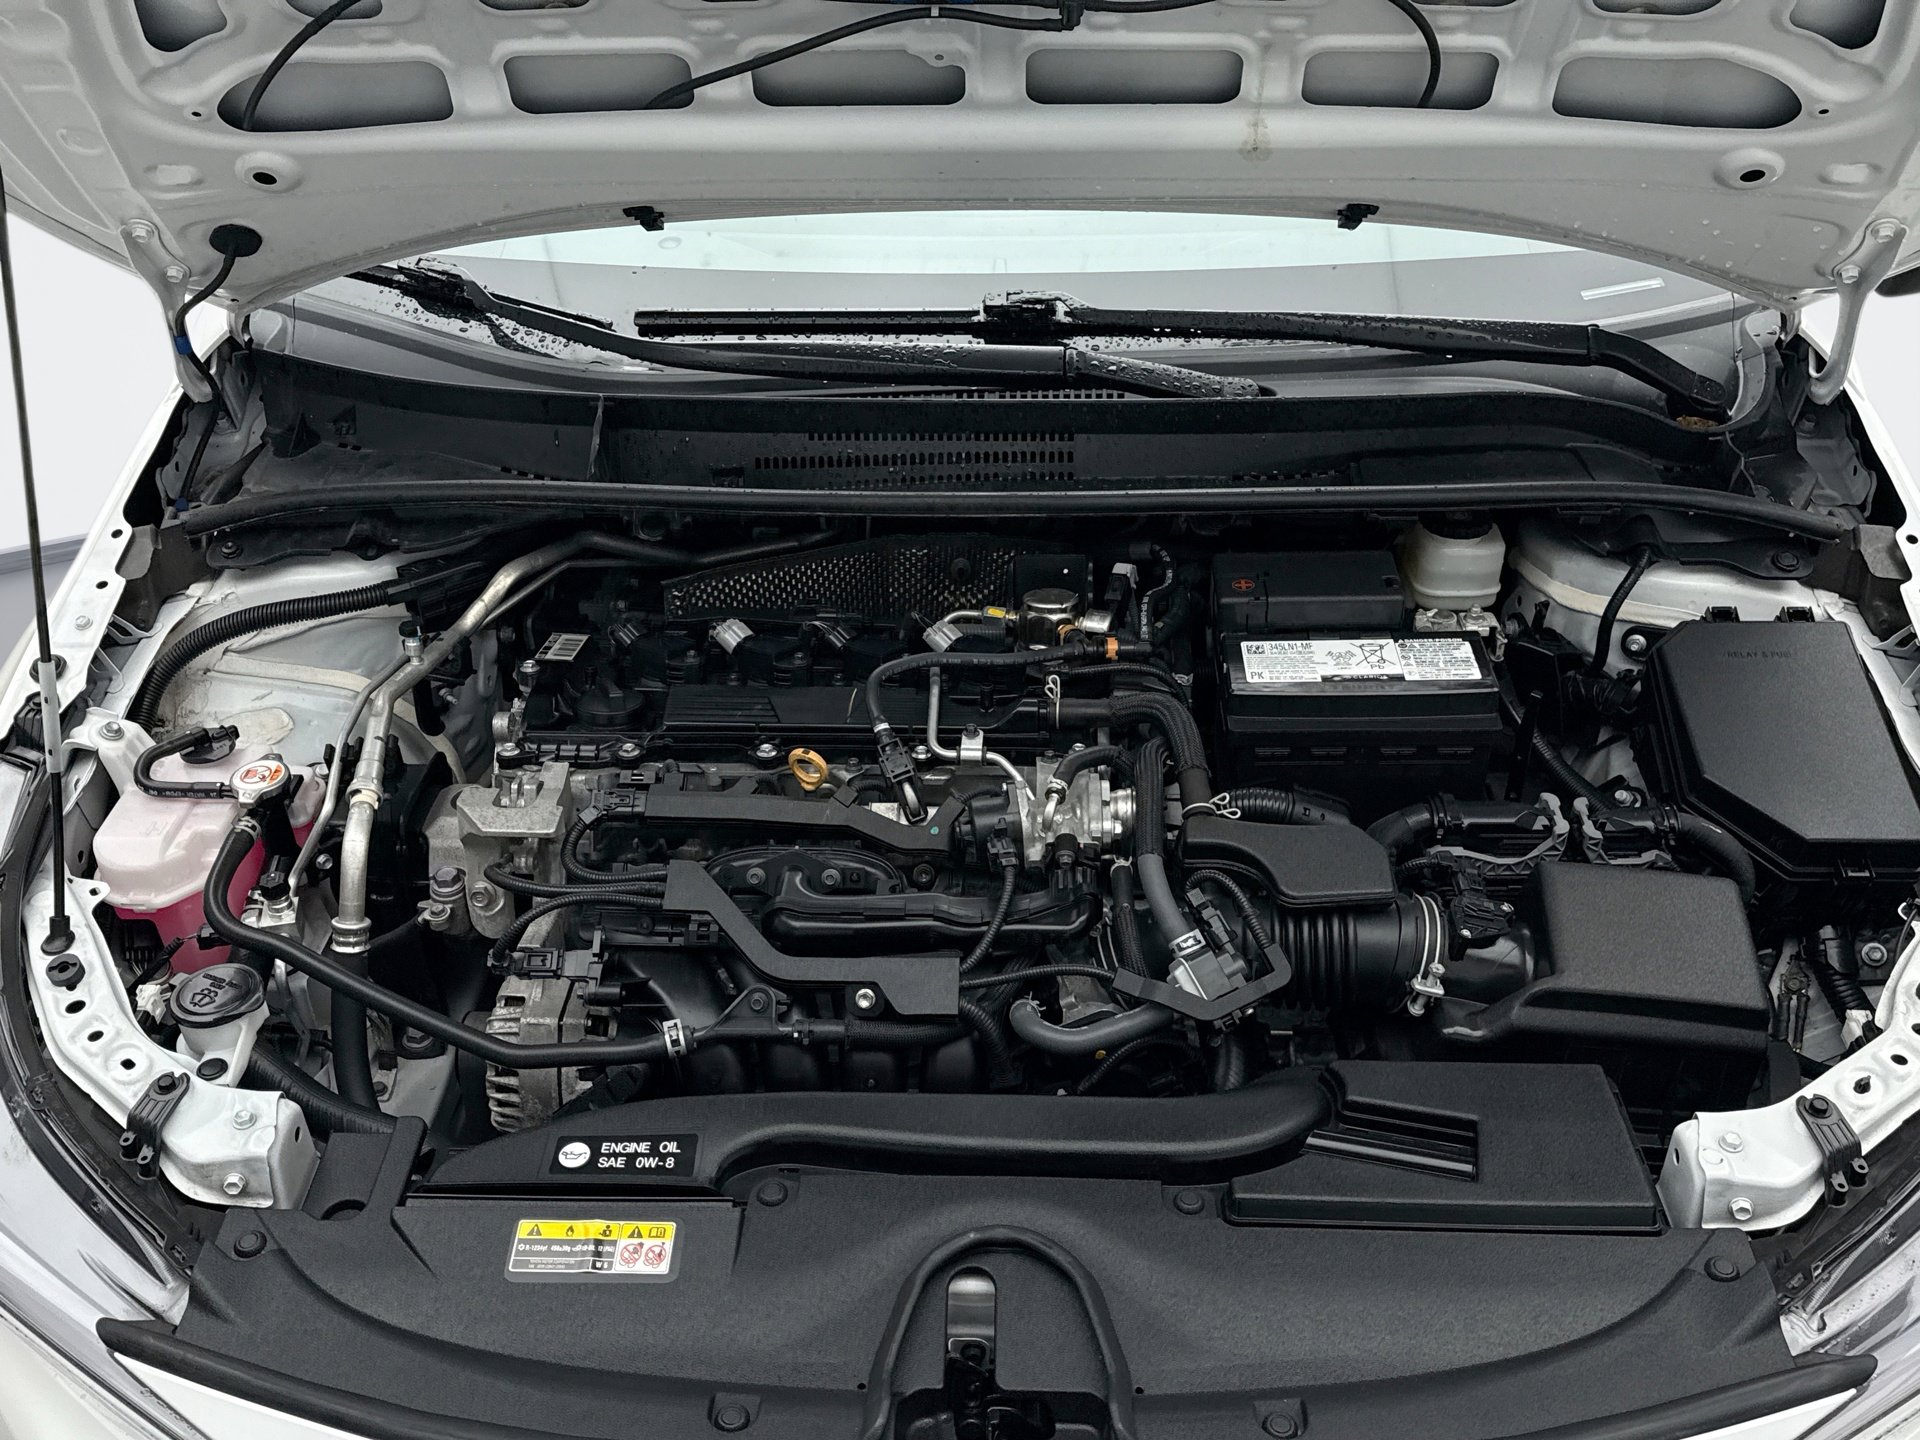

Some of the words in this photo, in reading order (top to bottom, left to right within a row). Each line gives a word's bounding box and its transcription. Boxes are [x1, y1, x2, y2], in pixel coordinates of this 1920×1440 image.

[1268, 642, 1313, 651] 345LN1-MF
[1250, 671, 1265, 679] PK
[600, 1142, 651, 1154] ENGINE
[659, 1141, 681, 1153] OIL
[597, 1157, 627, 1168] SAE
[635, 1157, 675, 1169] 0W-8
